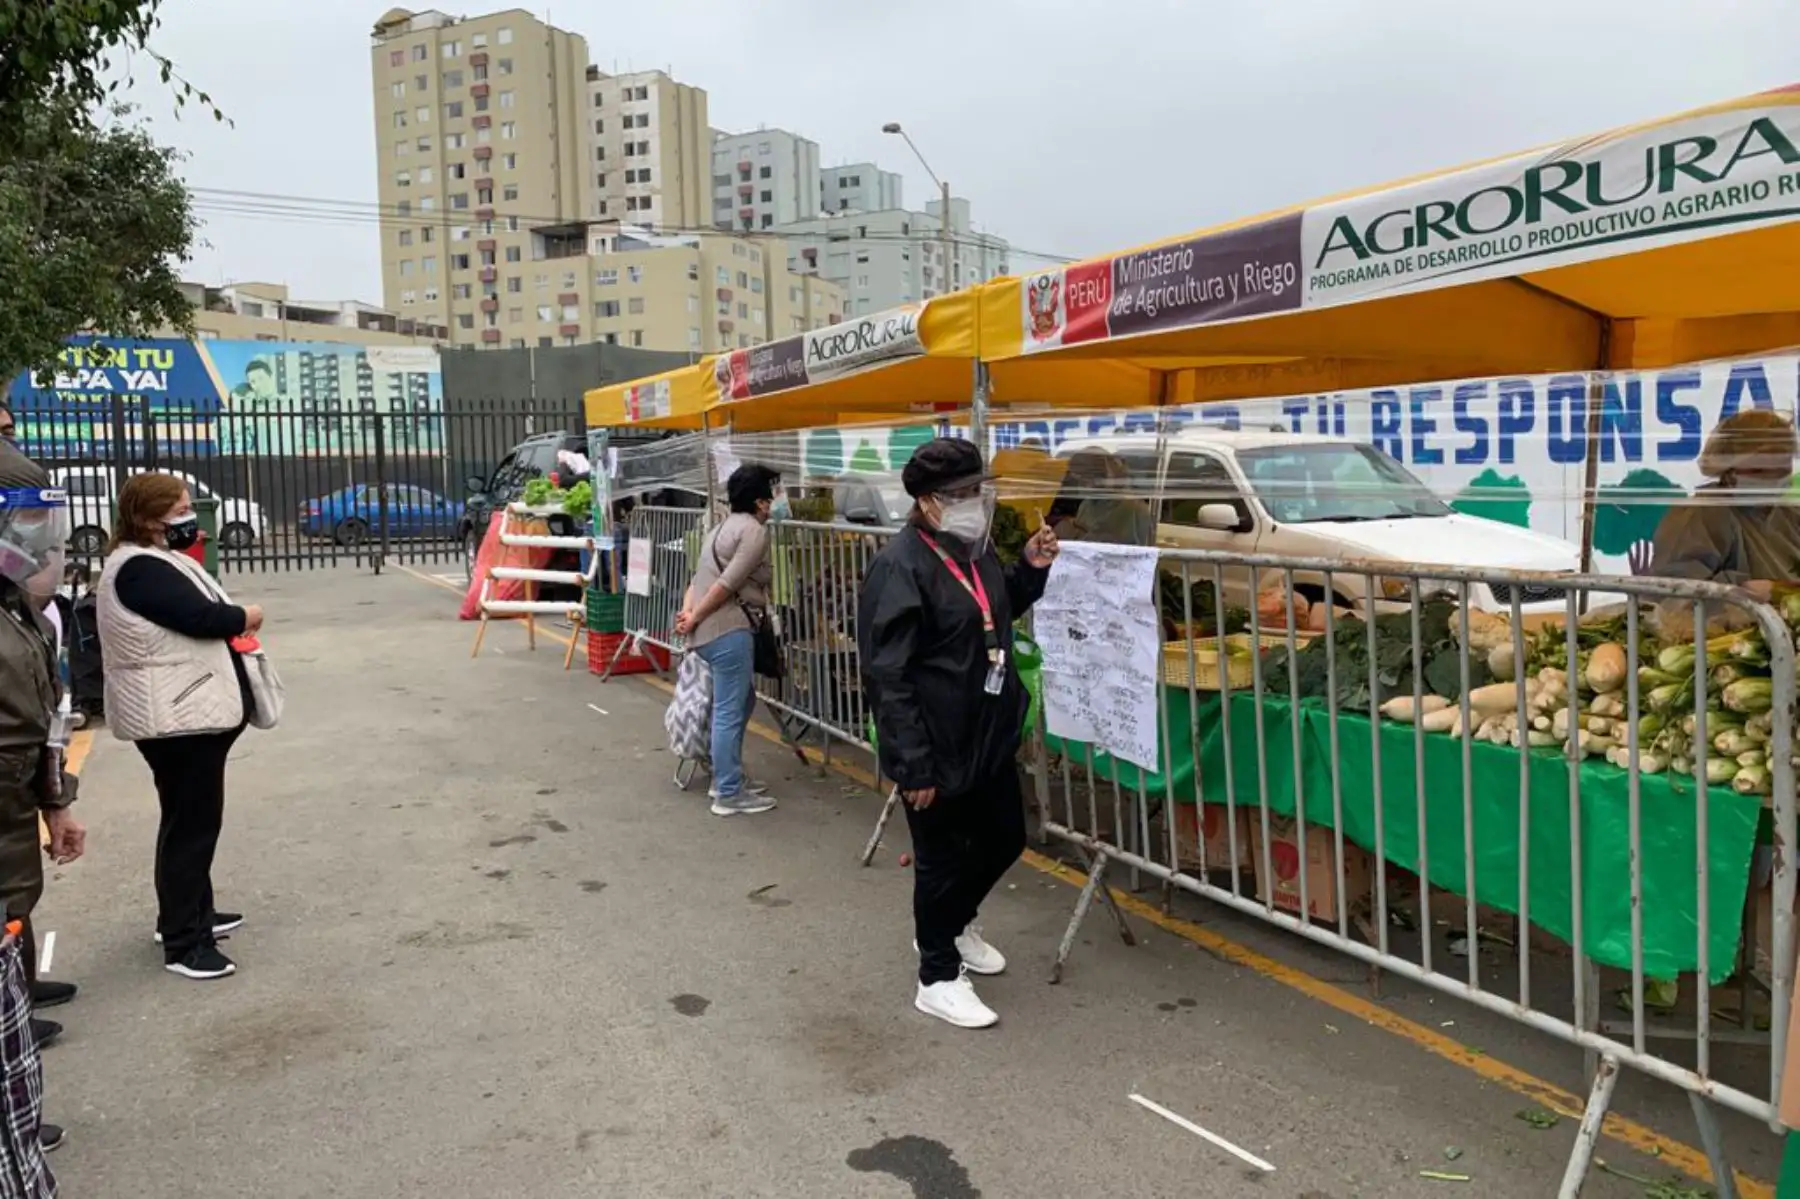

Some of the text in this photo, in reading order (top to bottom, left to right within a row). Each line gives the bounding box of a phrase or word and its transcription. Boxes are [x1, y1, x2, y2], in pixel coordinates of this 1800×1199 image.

[1315, 116, 1800, 269] AGRORURA
[1309, 260, 1391, 291] PROGRAMA
[1394, 257, 1414, 275] DE
[1417, 233, 1523, 271] DESARROLLO
[1527, 206, 1656, 249] PRODUCTIVO
[1662, 179, 1770, 220] AGRARIO
[1069, 271, 1107, 310] PERÚ
[1113, 260, 1297, 317] de Agricultura y Riego
[1118, 243, 1194, 285] Ministerio
[133, 347, 174, 370] TU
[1371, 362, 1800, 465] RESPONSA
